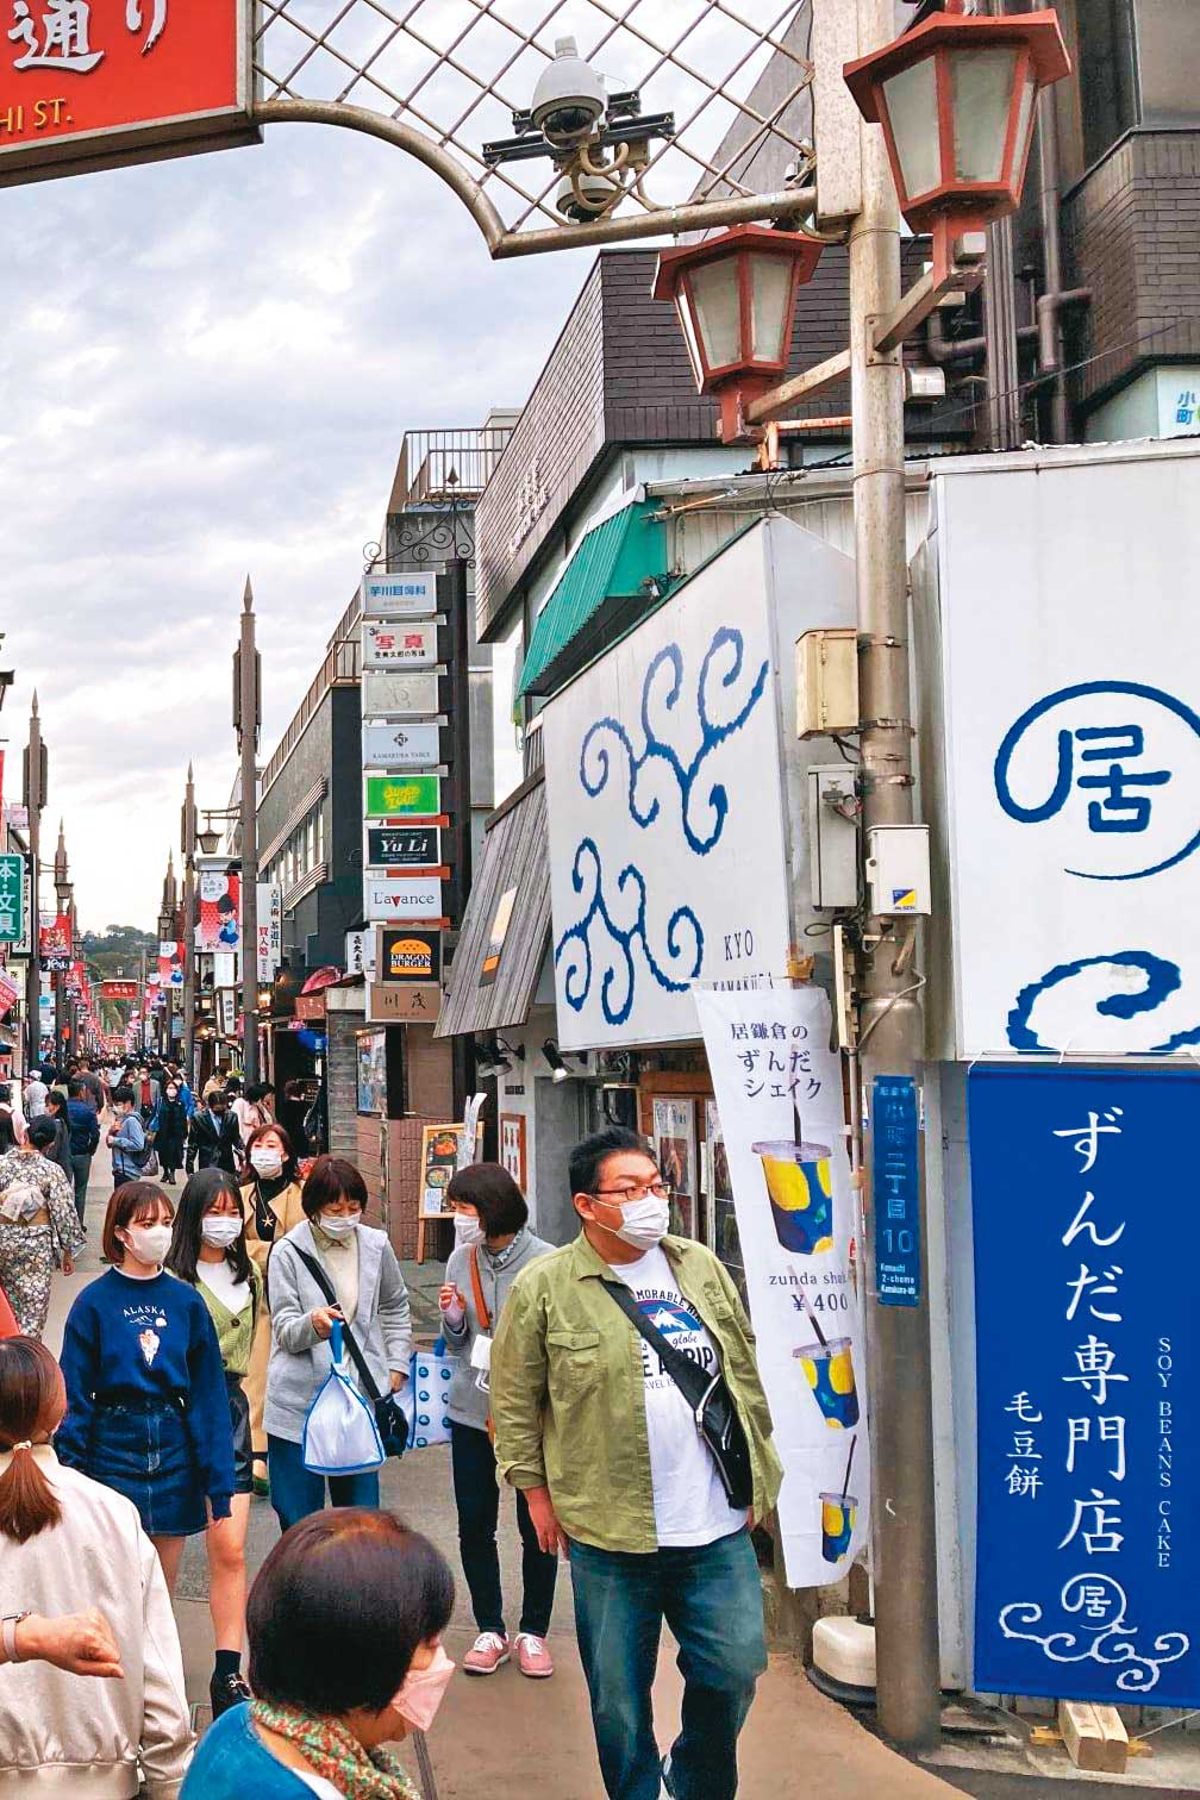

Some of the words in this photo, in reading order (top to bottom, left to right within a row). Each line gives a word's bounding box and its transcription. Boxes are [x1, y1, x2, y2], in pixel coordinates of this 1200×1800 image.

[33, 98, 73, 128] ST.
[407, 839, 428, 852] Li
[391, 953, 432, 961] DRAGON
[724, 930, 753, 961] KYO
[731, 1022, 808, 1041] 居鎌倉の
[737, 1049, 813, 1073] ずんだ
[744, 1078, 822, 1100] シェイク
[883, 1229, 913, 1253] 10
[769, 1271, 818, 1286] zunda
[123, 1305, 166, 1318] ALASKA
[672, 1331, 698, 1349] globe
[1052, 1106, 1130, 1555] ずんだ専門店
[1157, 1337, 1173, 1388] SOY
[1003, 1391, 1044, 1500] 毛豆餅
[1158, 1401, 1173, 1488] BEANS
[1157, 1501, 1172, 1568] CAKE
